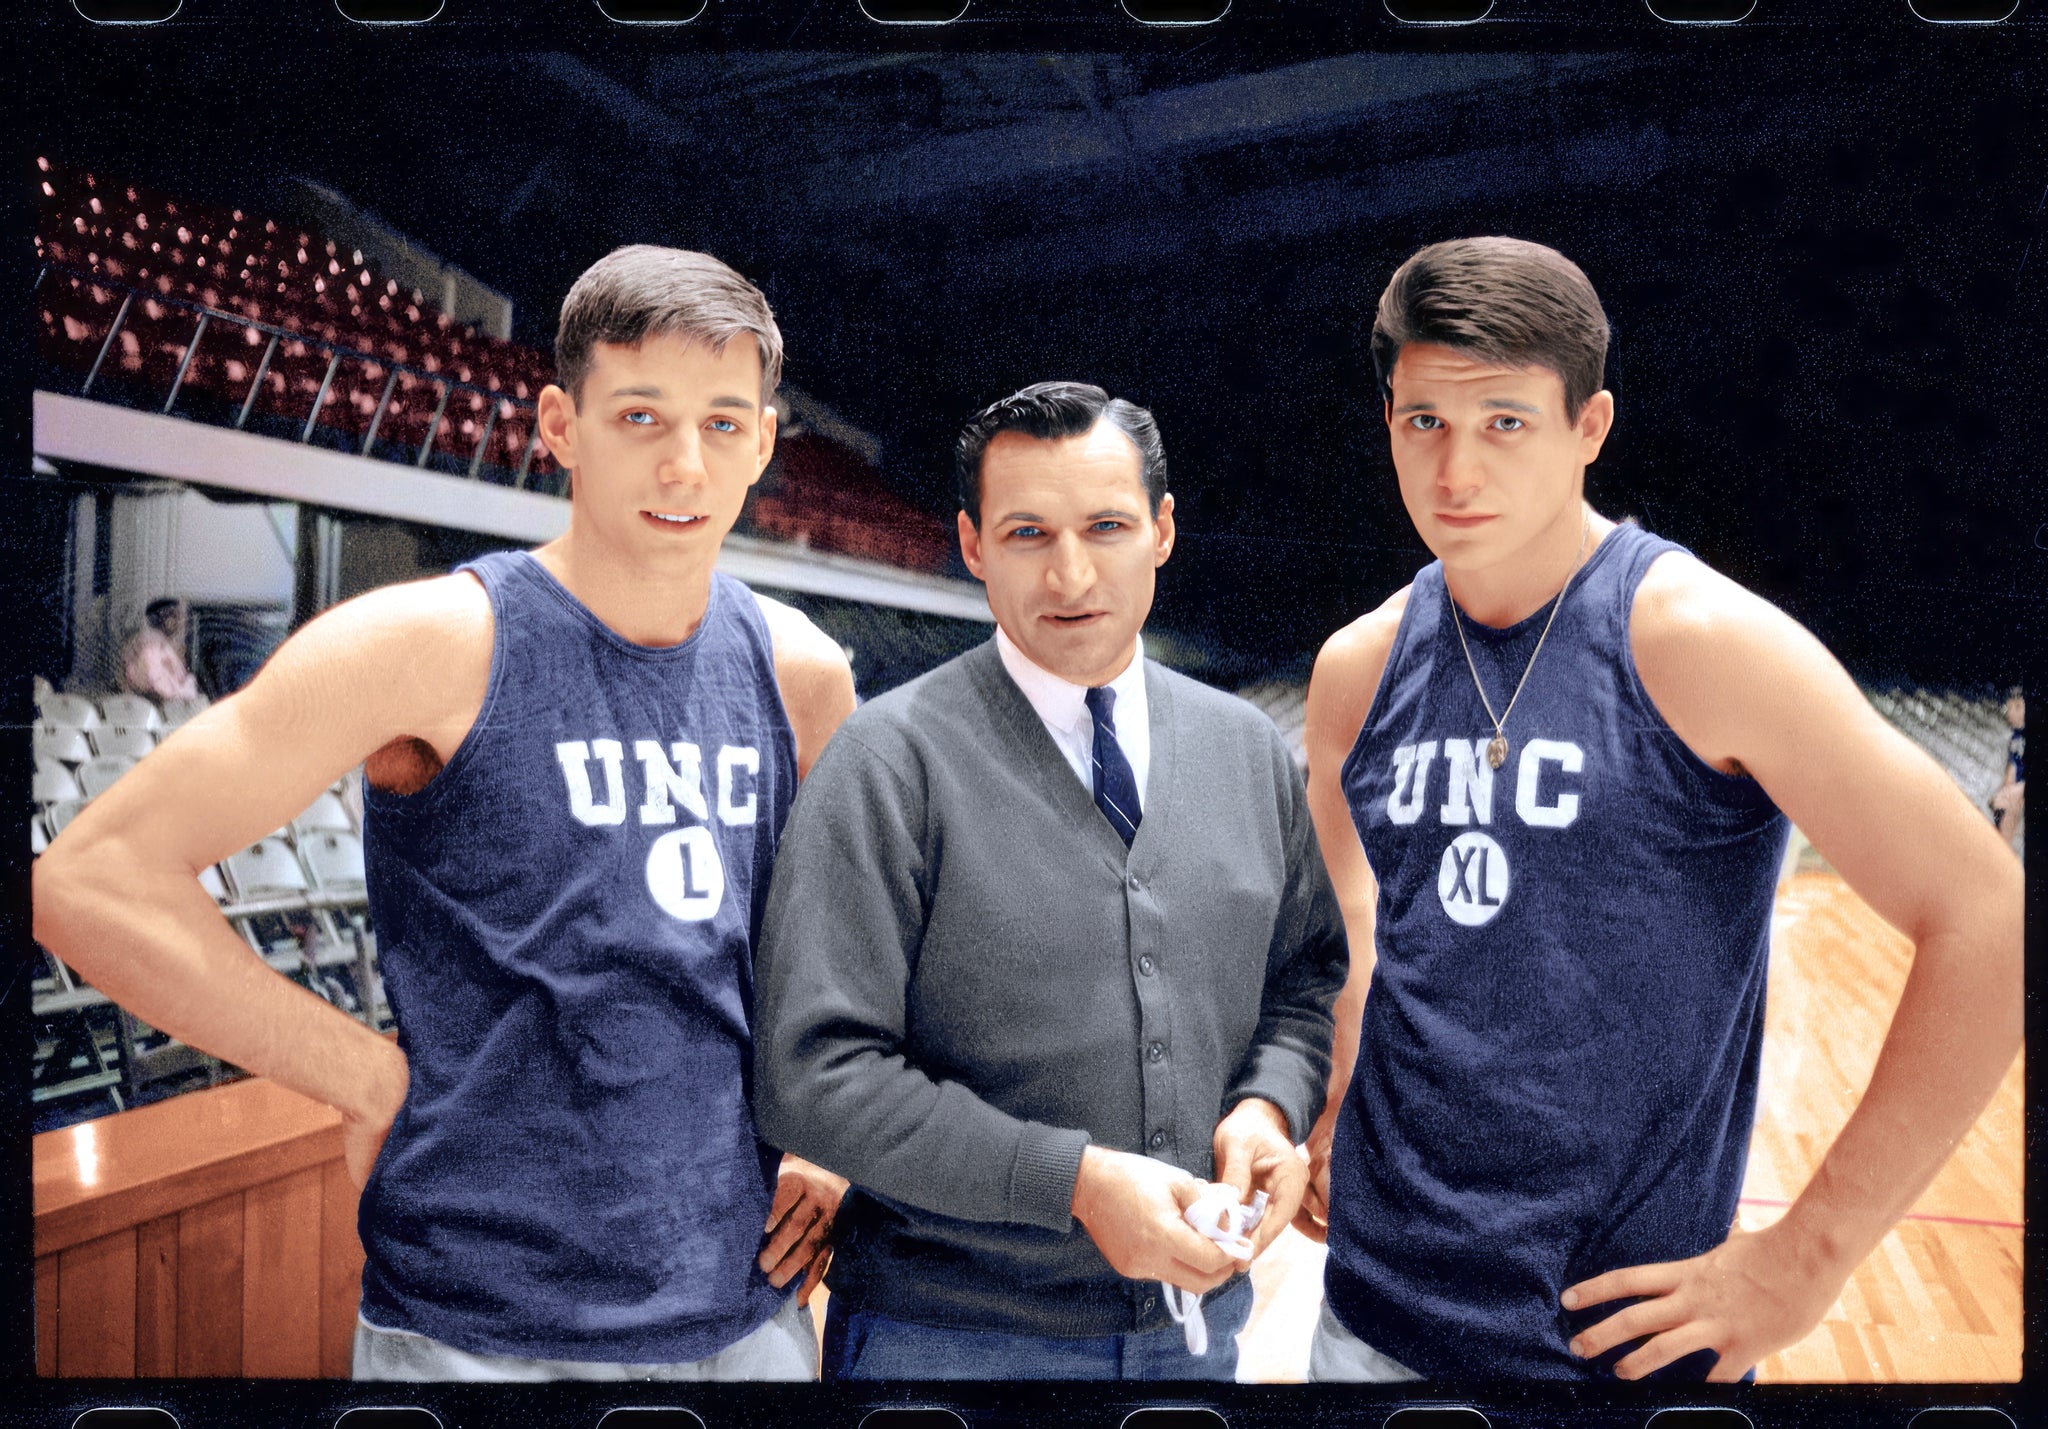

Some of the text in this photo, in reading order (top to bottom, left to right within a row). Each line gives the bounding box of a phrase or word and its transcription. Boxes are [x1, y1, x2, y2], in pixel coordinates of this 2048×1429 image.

[556, 739, 759, 826] UNC
[1387, 738, 1583, 828] UNC
[679, 842, 709, 899] L
[1447, 845, 1500, 906] XL
